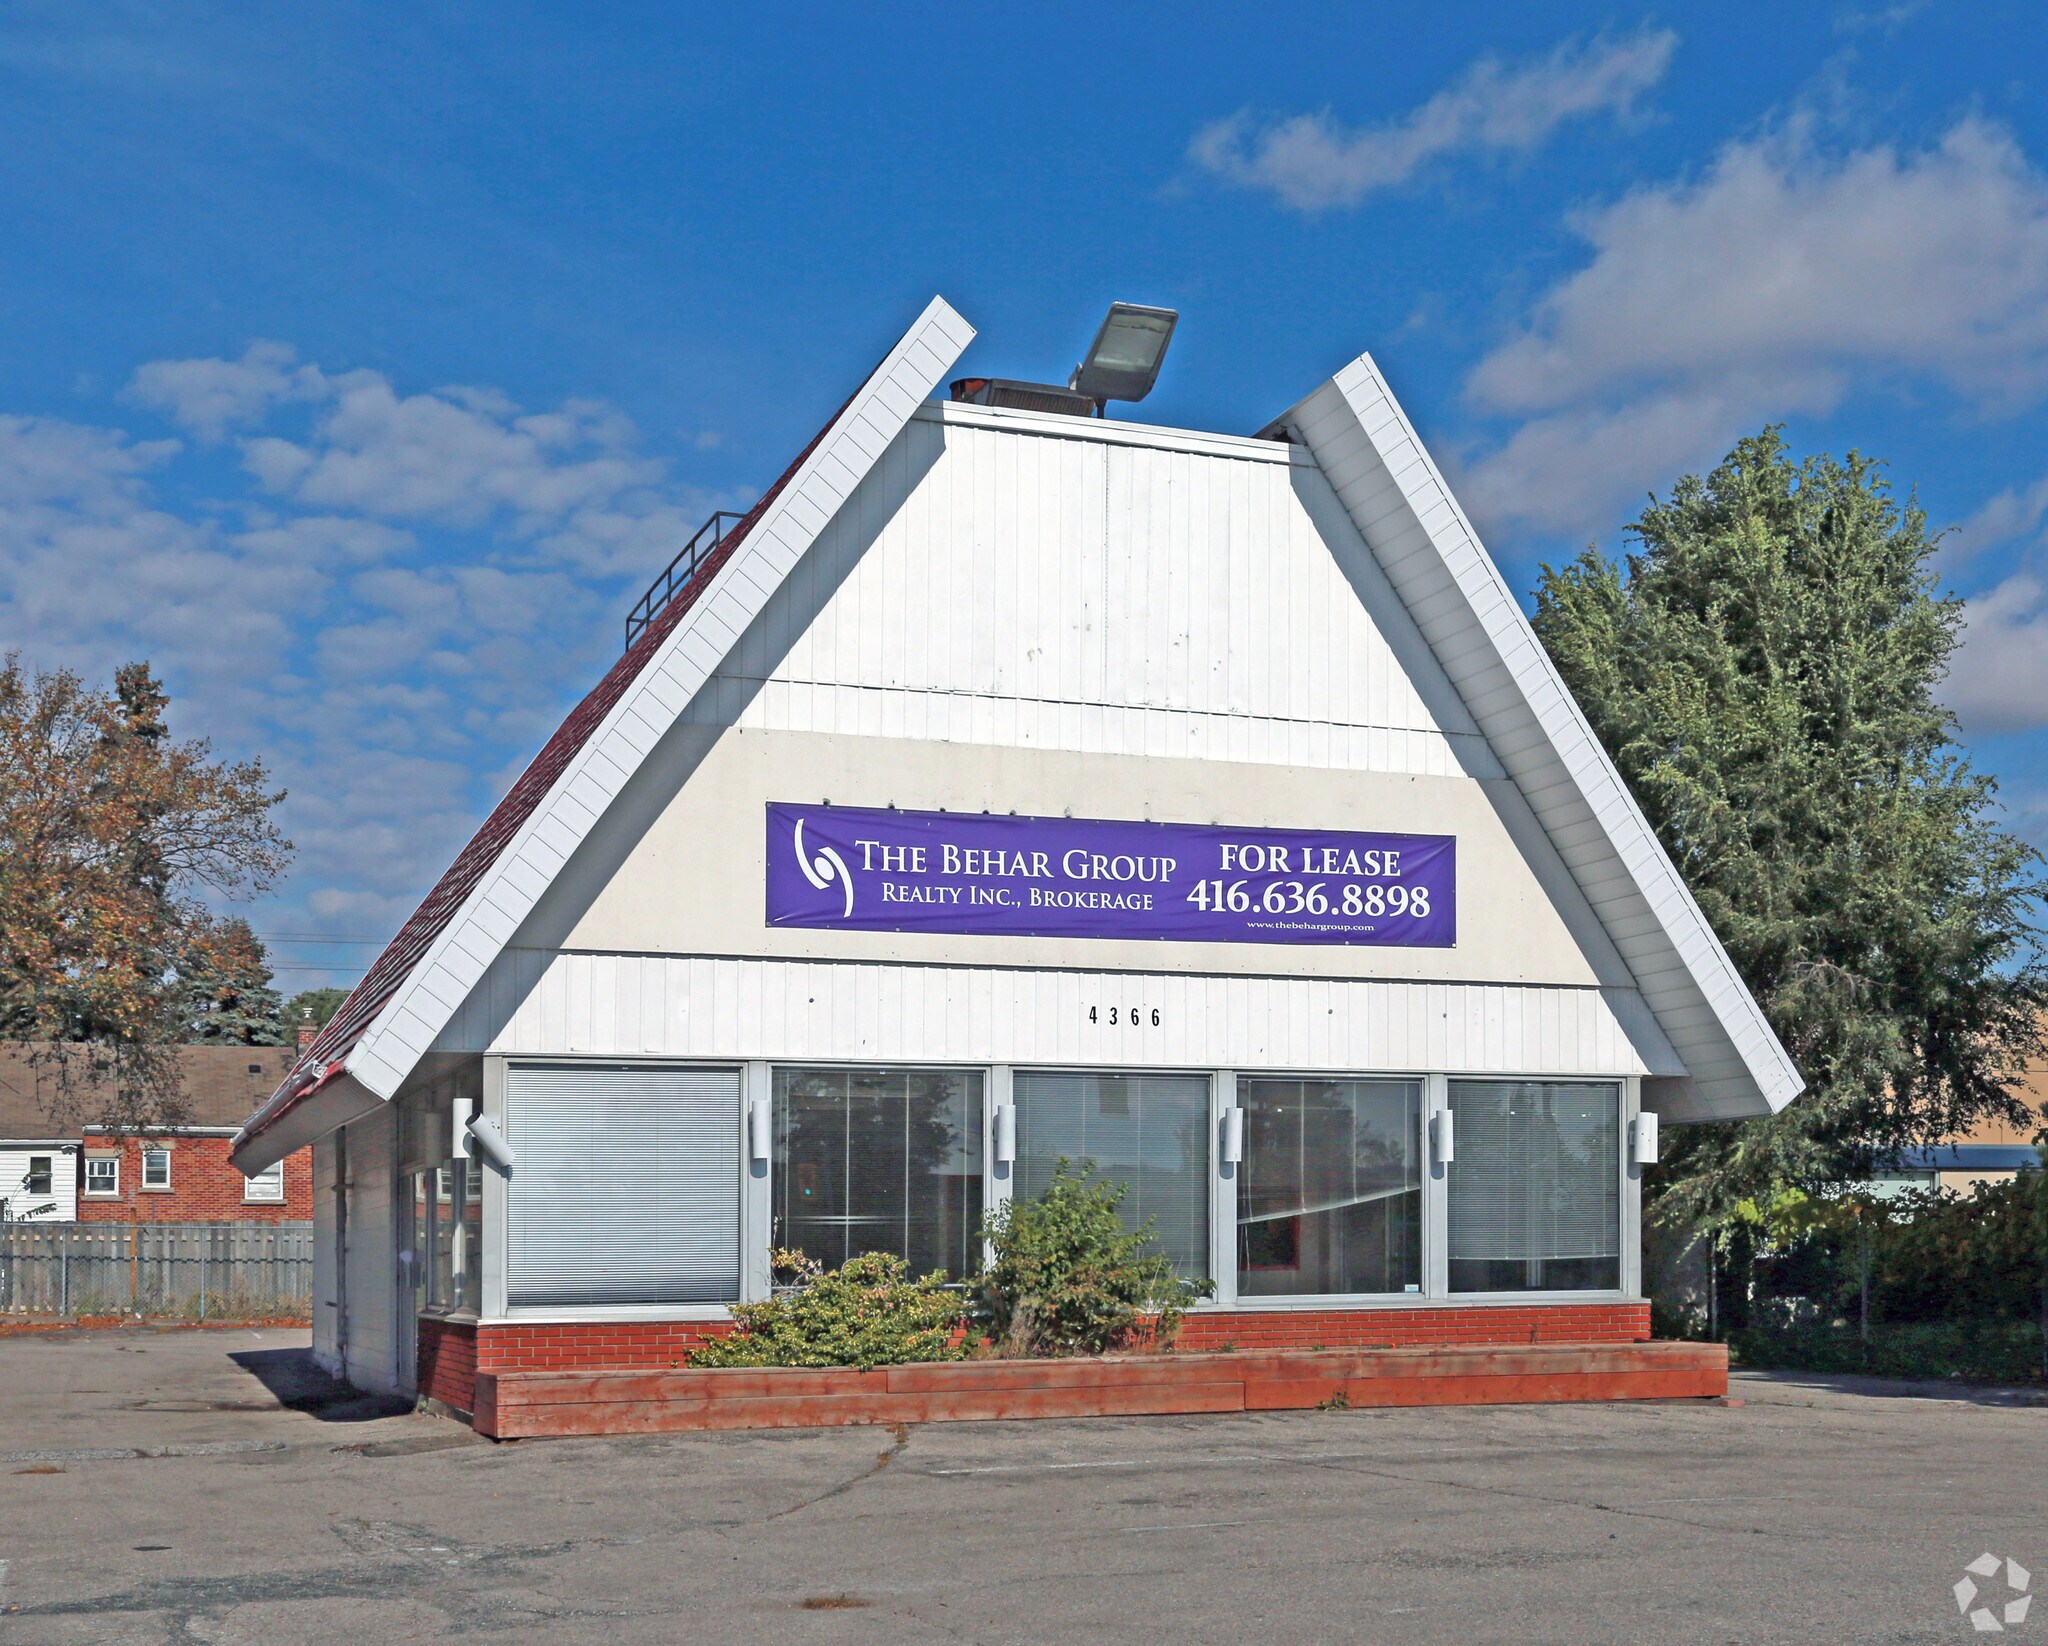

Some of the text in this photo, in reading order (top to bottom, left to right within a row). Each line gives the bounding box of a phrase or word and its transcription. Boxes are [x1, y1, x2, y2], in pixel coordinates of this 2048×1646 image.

[855, 840, 1177, 883] THE BEHAR GROUP
[1219, 844, 1401, 877] FOR LEASE
[882, 882, 963, 905] REALTY
[1029, 889, 1153, 911] BROKERAGE
[1186, 879, 1431, 918] 416.636.8898
[1247, 921, 1375, 932] www.thebehargroup.com
[1089, 1005, 1160, 1026] 4366
